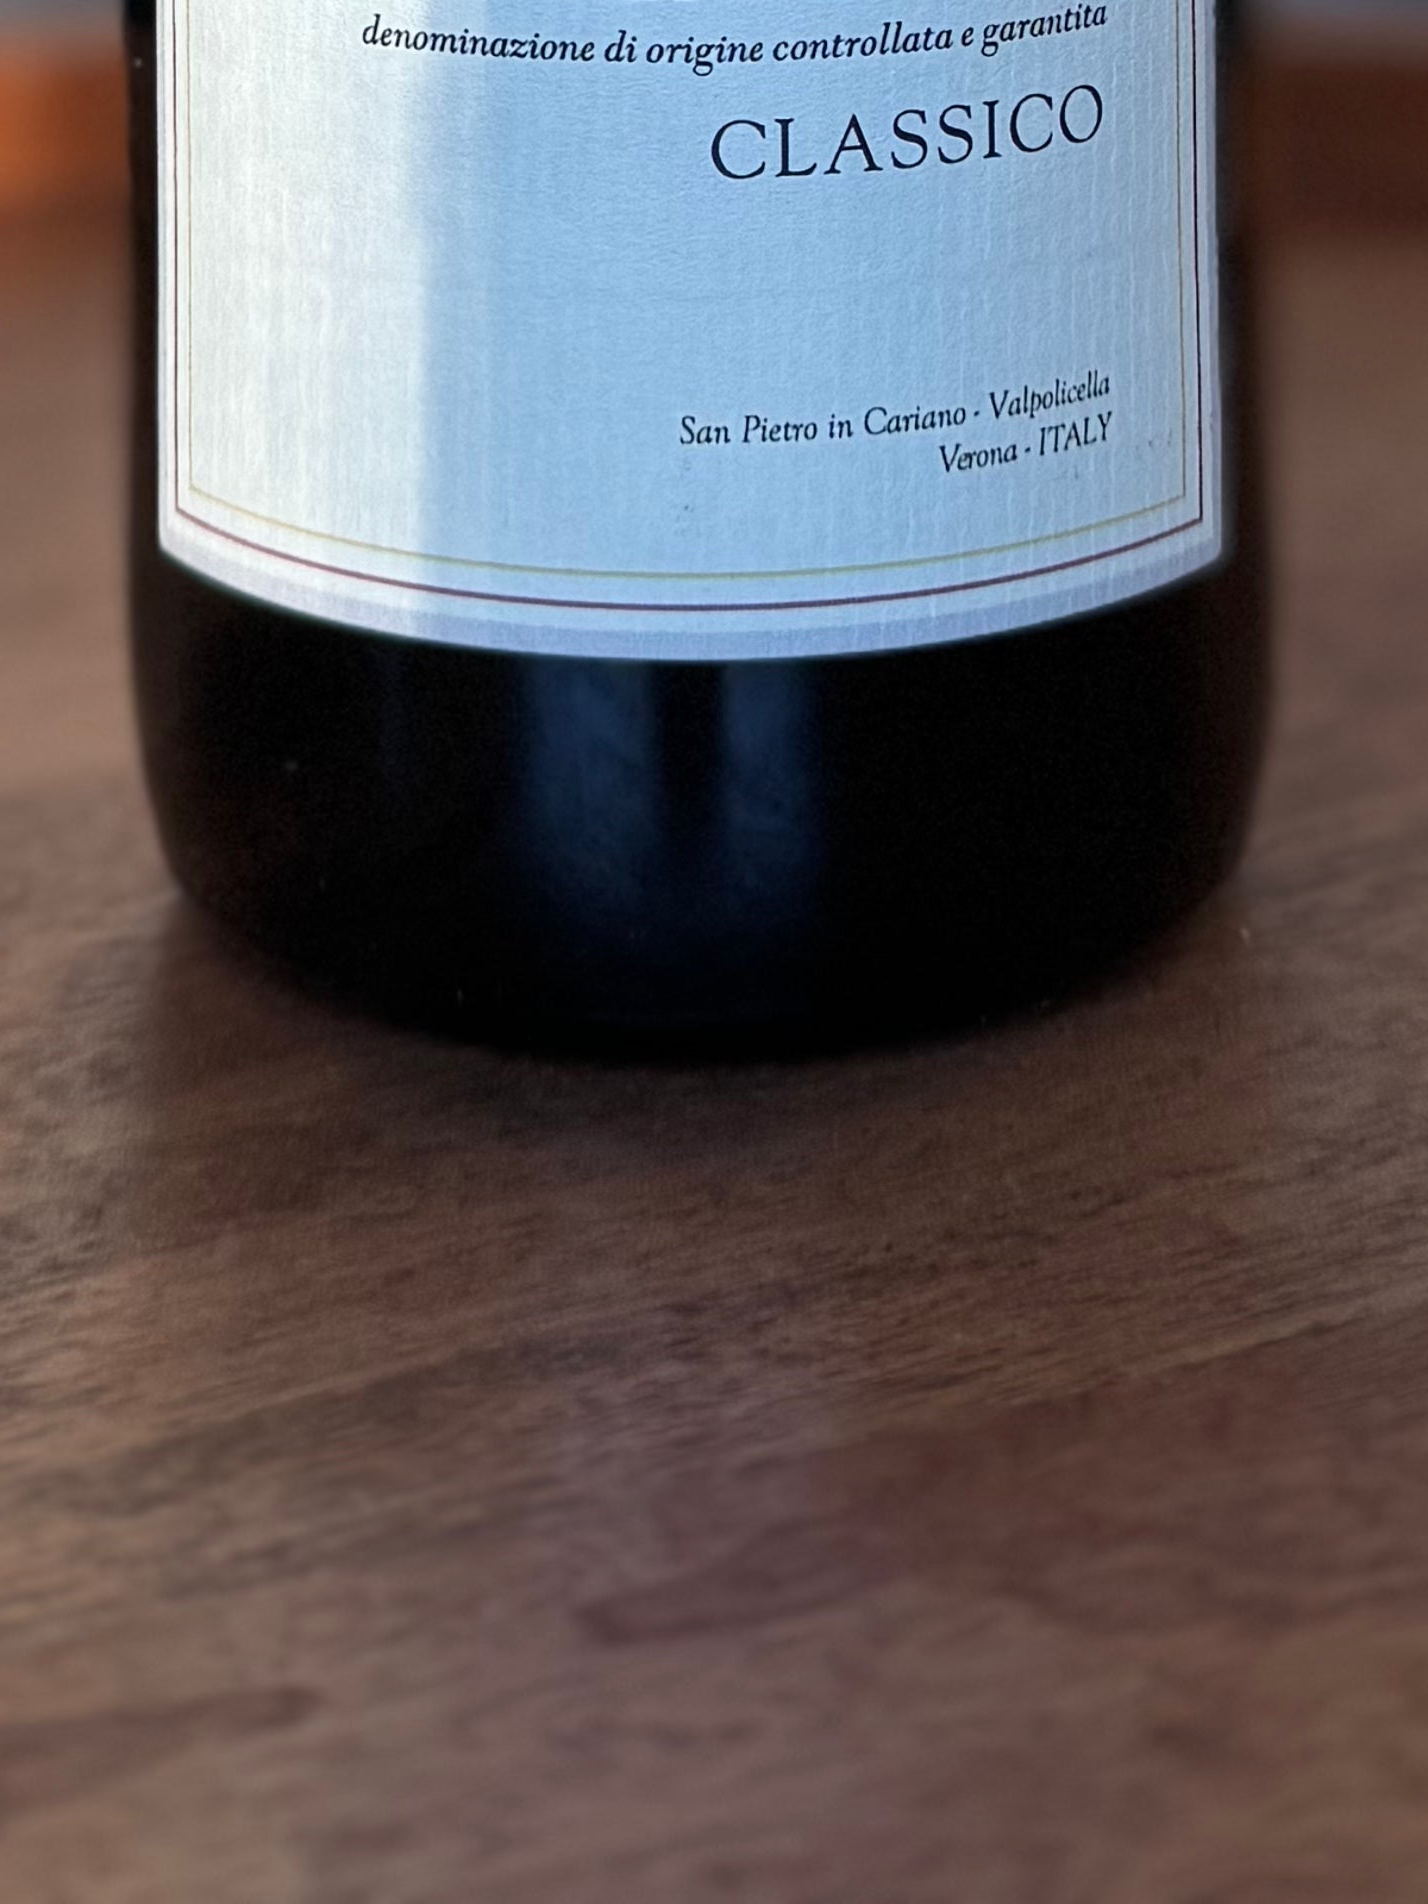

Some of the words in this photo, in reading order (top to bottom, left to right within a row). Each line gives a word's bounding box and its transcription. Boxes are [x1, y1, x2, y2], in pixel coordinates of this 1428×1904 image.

[361, 14, 595, 64] denominazione
[603, 30, 637, 64] di
[645, 30, 763, 76] origine
[772, 20, 954, 62] controllata
[960, 30, 974, 49] e
[980, 1, 1109, 58] garantita
[710, 84, 1105, 182] CLASSICO
[679, 415, 731, 445] San
[743, 414, 818, 443] Pietro
[829, 415, 853, 439] in
[864, 406, 967, 436] Cariano
[989, 369, 1111, 420] Valpolicella
[939, 442, 1019, 473] Verona
[1038, 410, 1114, 456] ITALY
